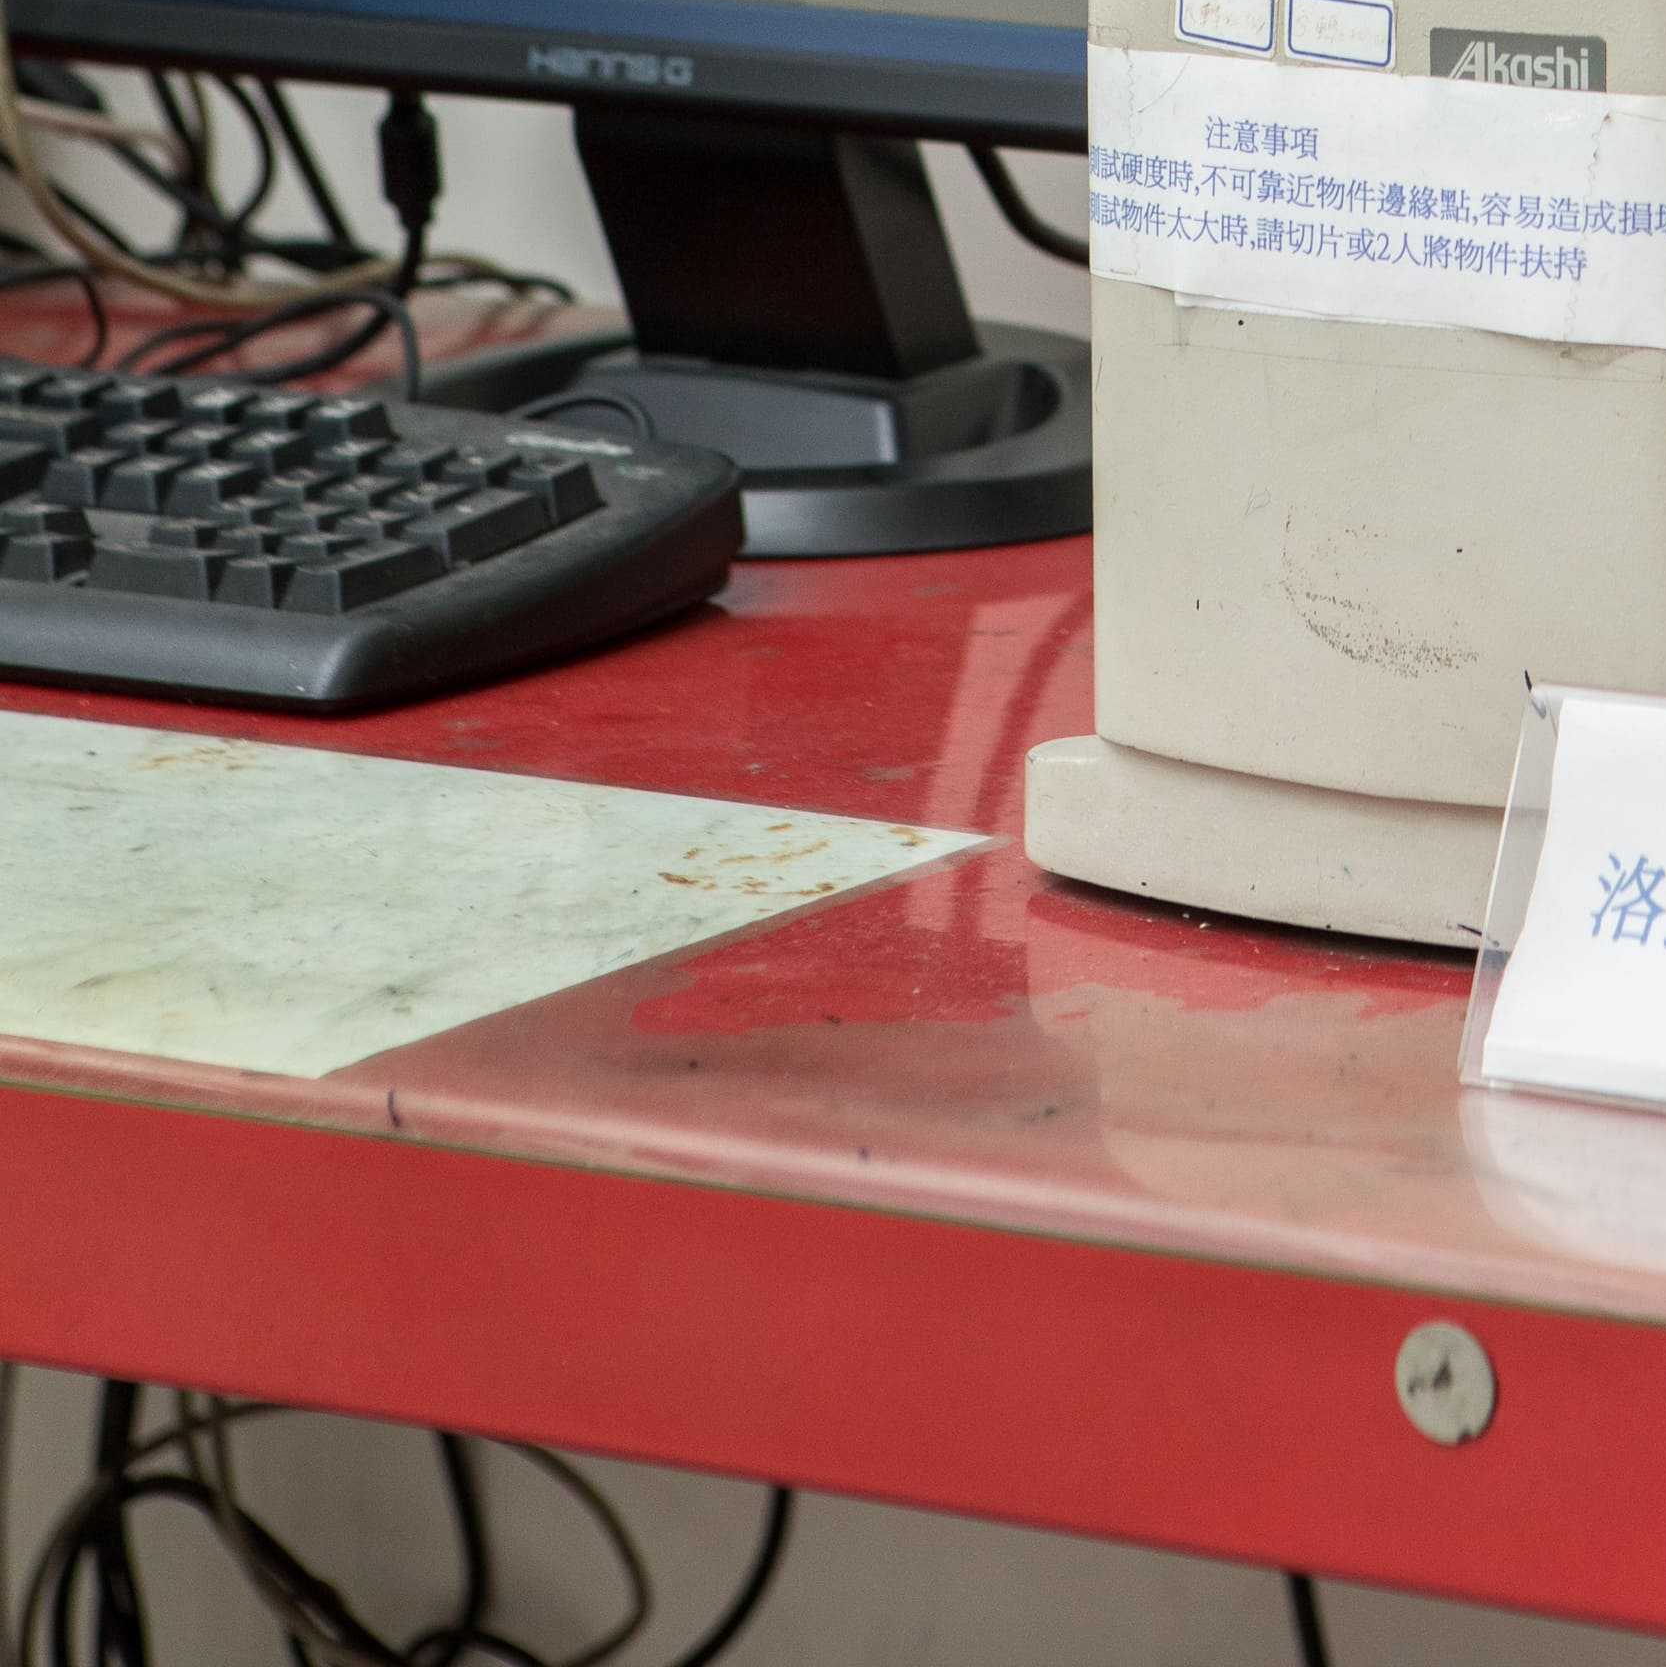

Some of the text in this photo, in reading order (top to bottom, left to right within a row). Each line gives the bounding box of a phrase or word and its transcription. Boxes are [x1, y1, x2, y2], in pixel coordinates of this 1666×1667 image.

[1449, 41, 1589, 91] Akashi
[1205, 116, 1319, 162] 注意事項
